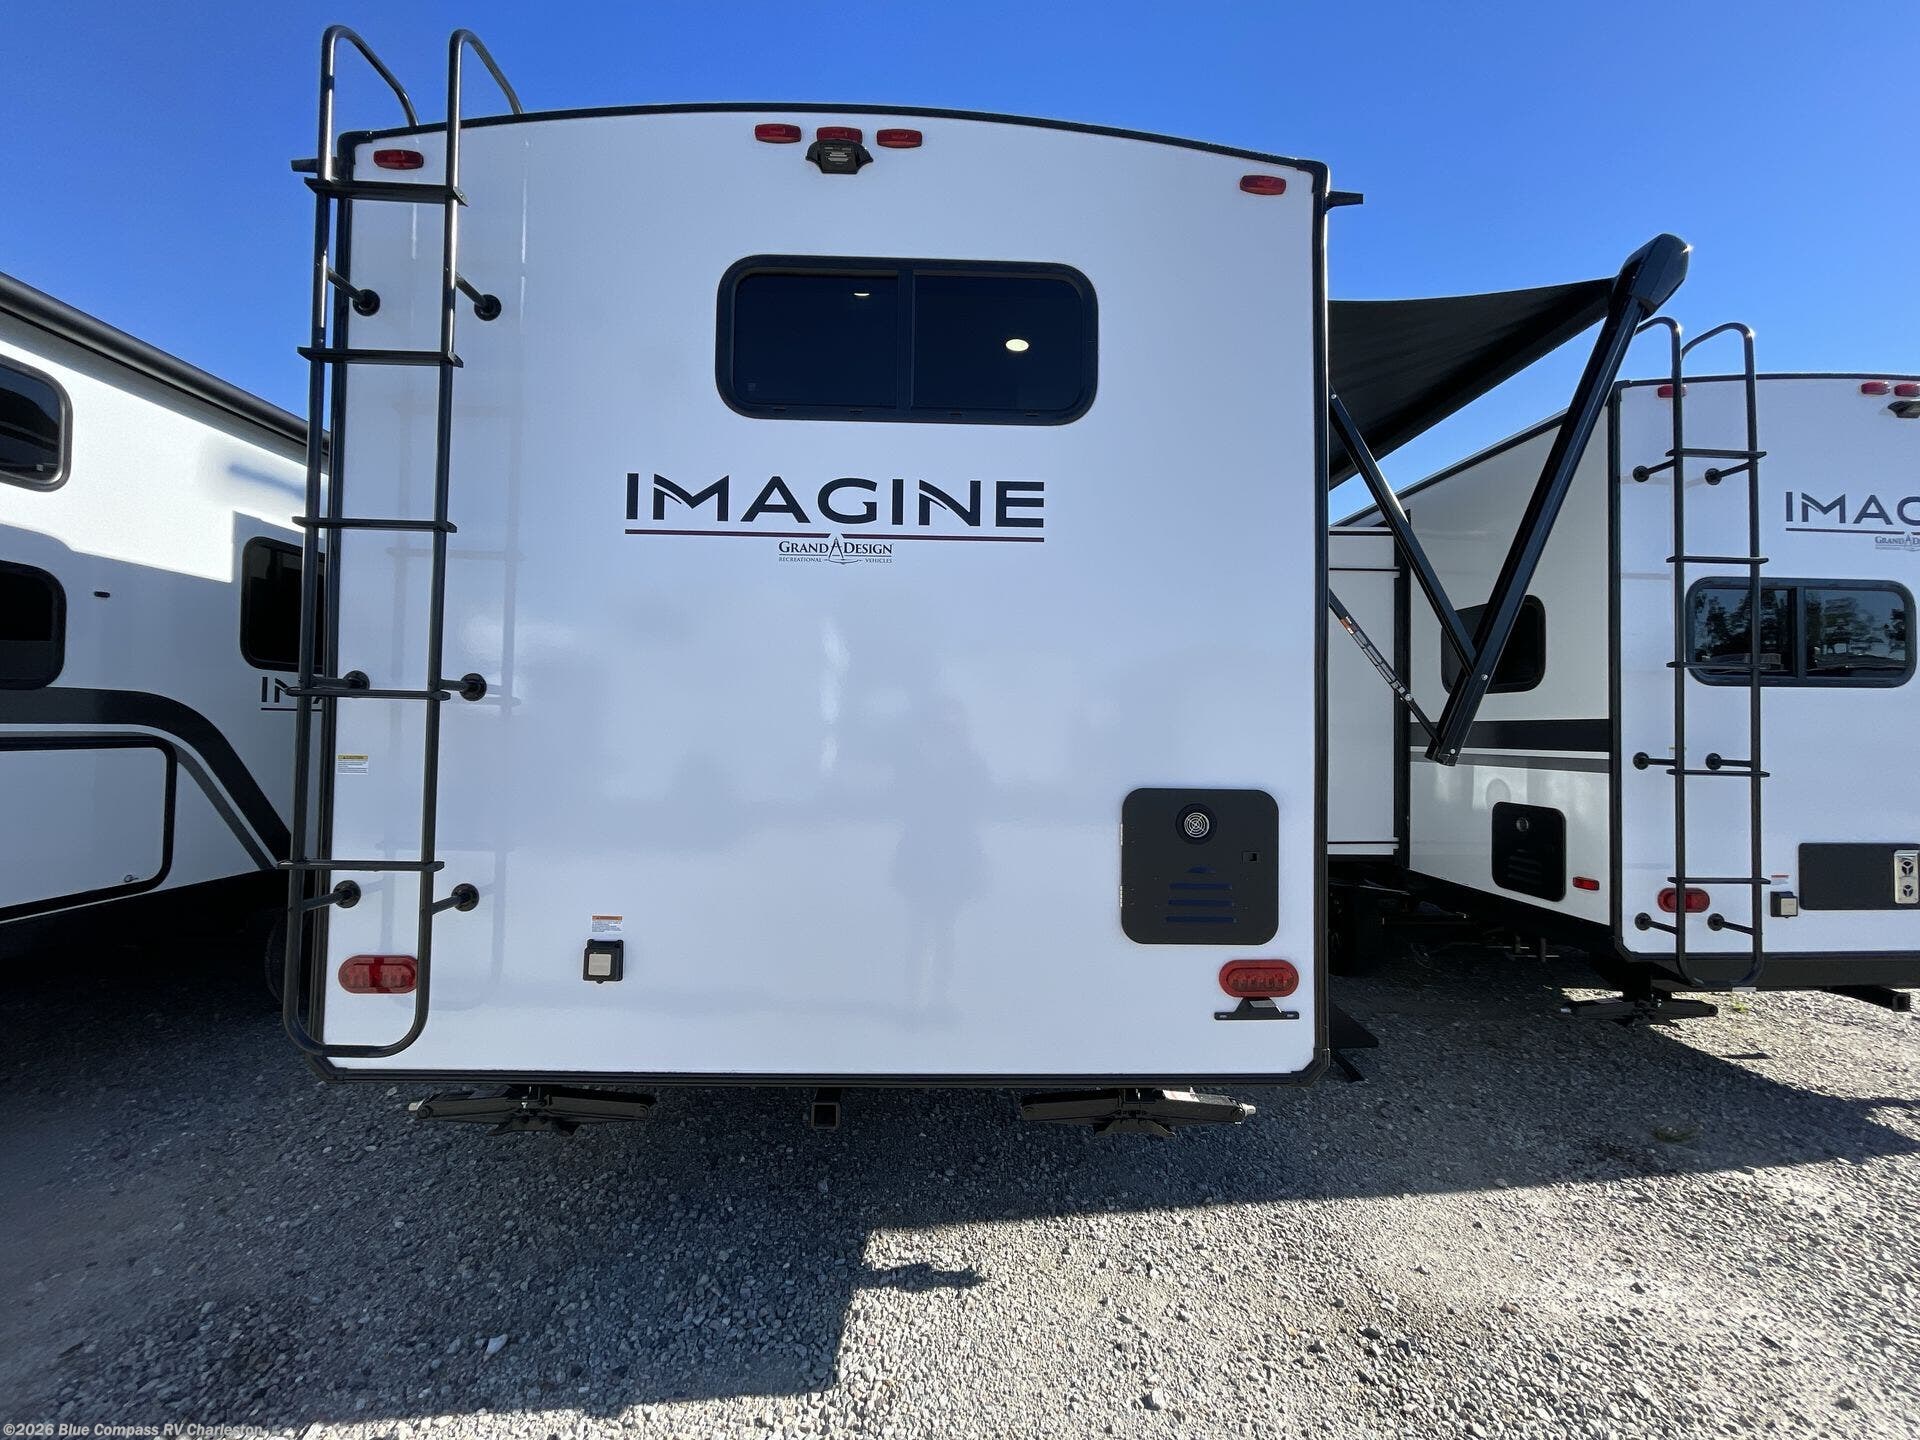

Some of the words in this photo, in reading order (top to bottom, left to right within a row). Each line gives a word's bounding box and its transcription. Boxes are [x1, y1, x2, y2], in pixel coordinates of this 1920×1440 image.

[626, 472, 1045, 528] IMAGINE
[778, 541, 829, 554] GRAND
[843, 542, 893, 555] DESIGN
